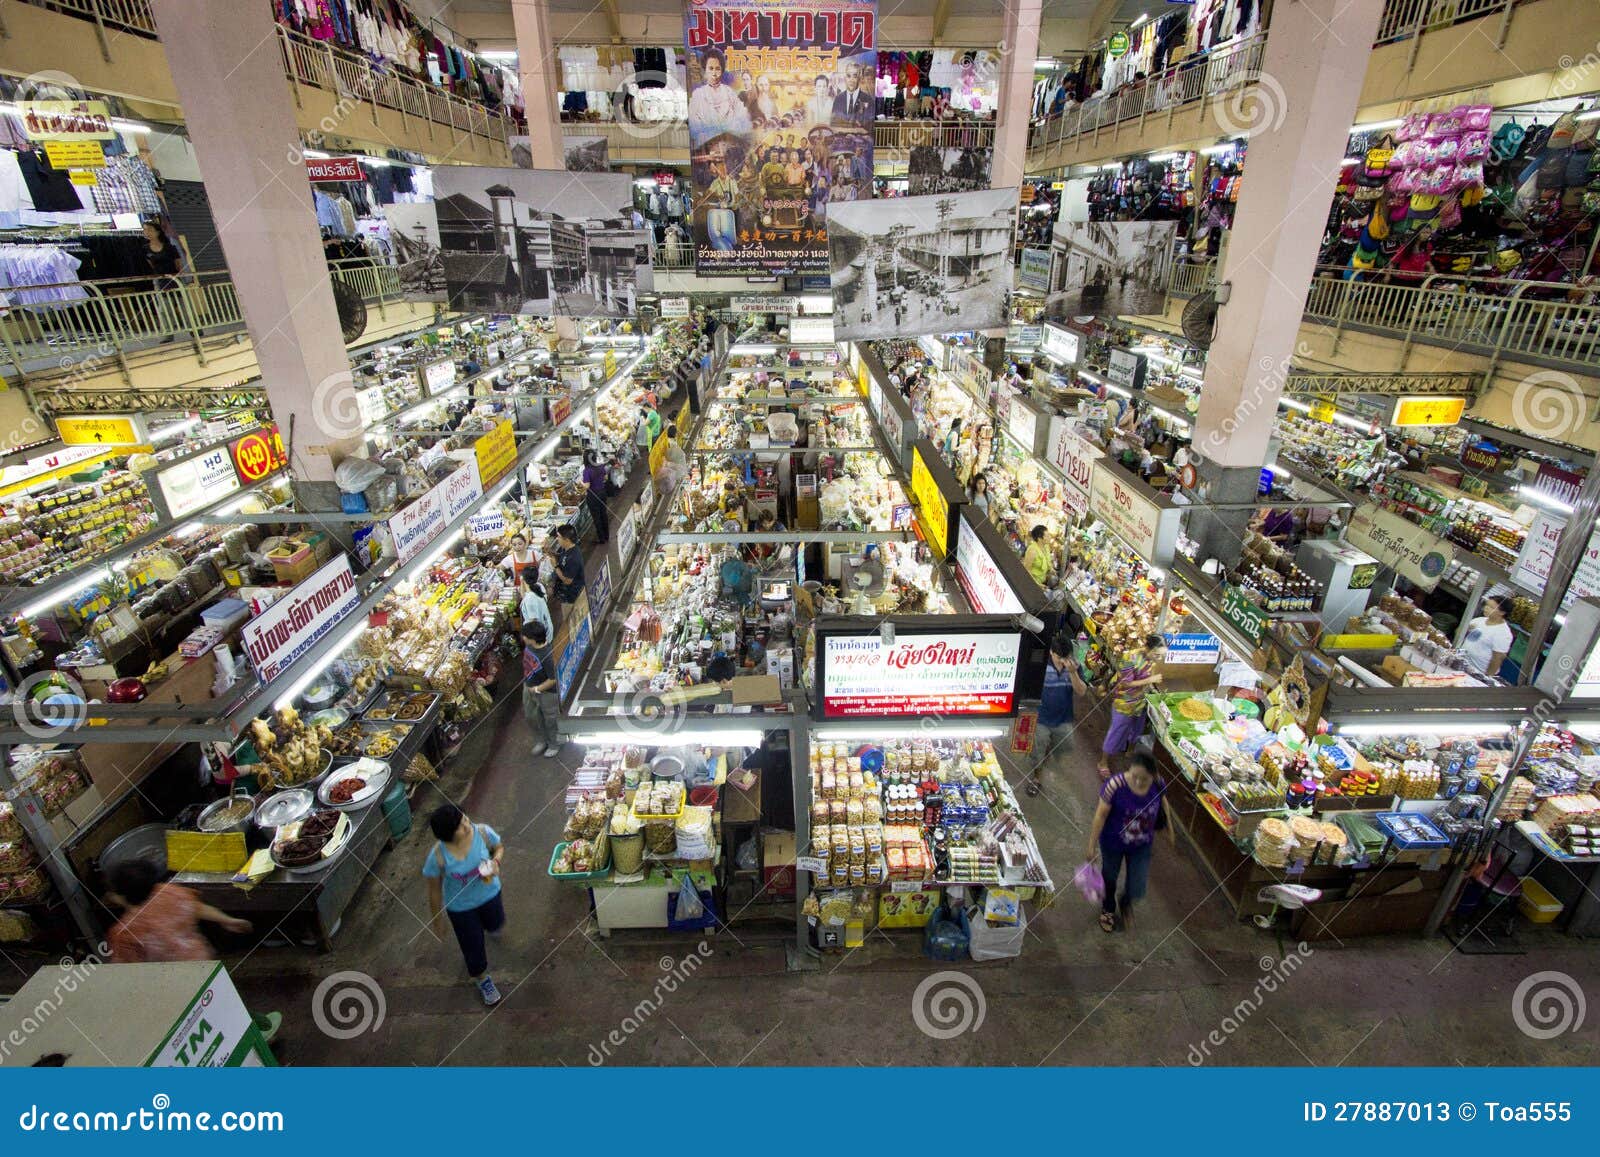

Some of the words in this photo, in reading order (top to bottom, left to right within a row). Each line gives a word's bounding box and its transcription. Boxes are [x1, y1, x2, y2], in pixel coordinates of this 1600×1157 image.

[688, 8, 875, 50] มหากาด
[307, 161, 356, 177] ทยประสิทธิ์
[993, 682, 1009, 690] GMP
[174, 1018, 213, 1066] TM
